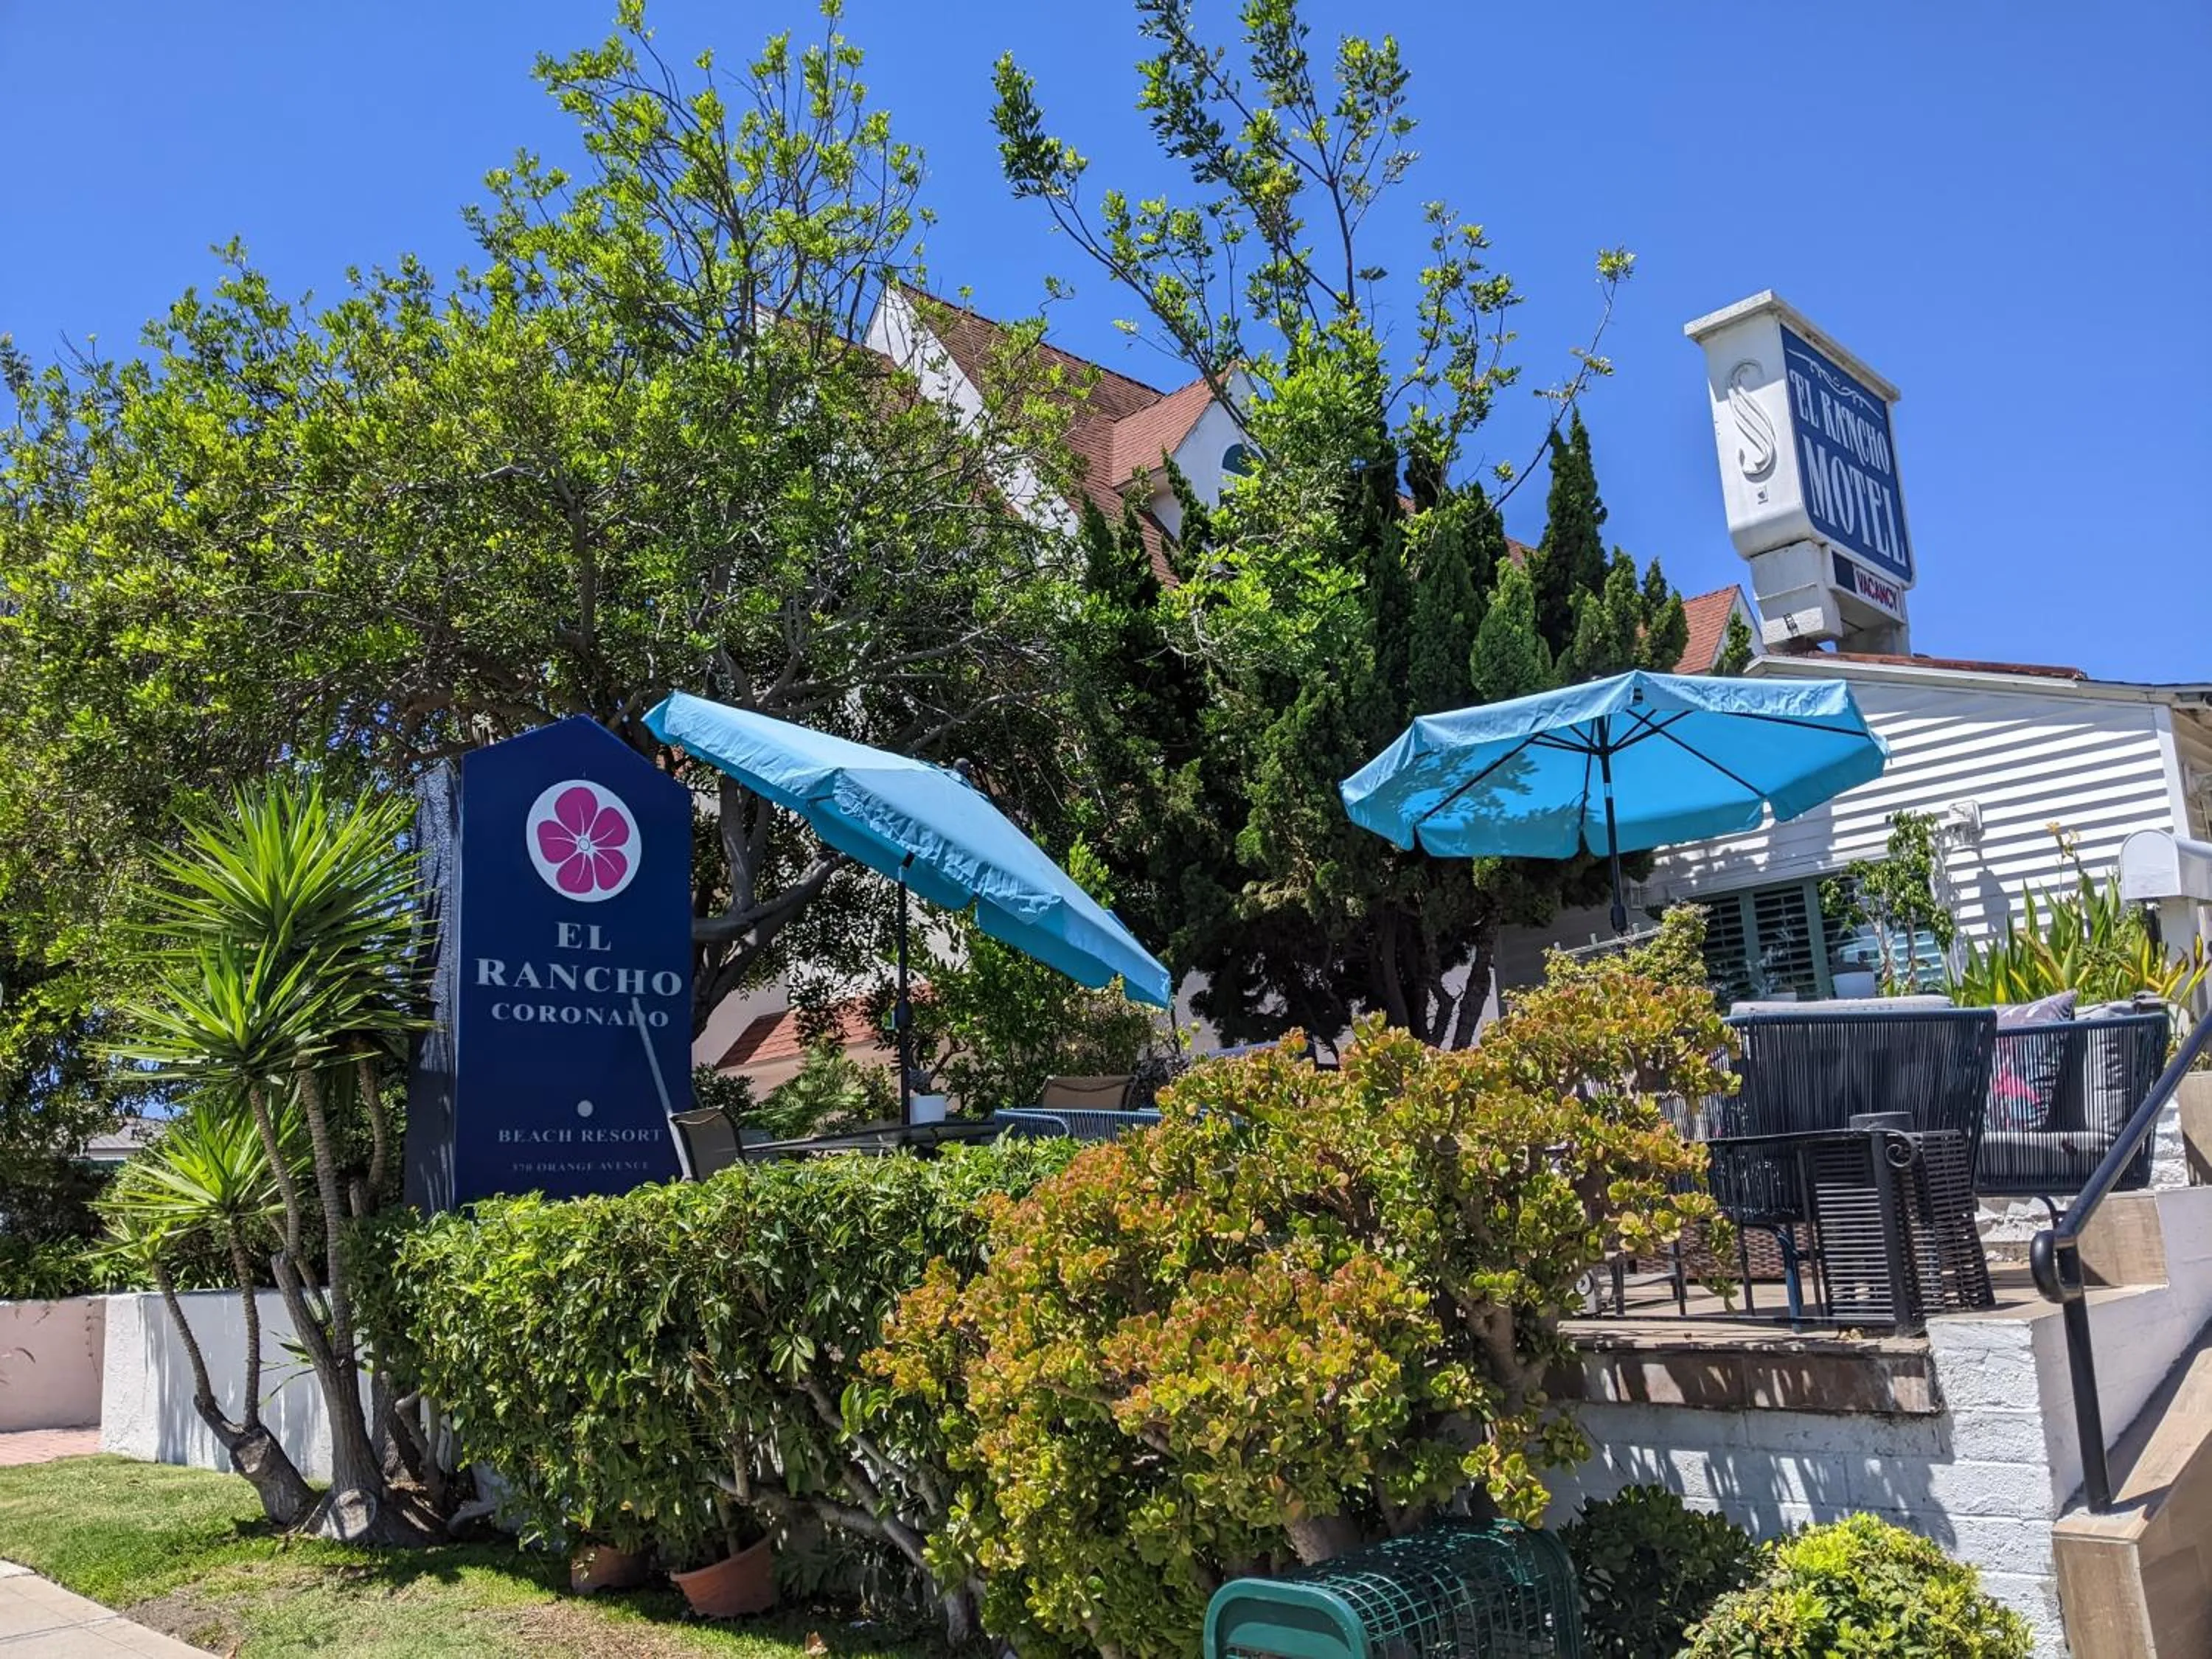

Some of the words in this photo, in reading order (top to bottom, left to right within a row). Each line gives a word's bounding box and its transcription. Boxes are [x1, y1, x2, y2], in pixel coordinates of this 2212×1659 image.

[1789, 369, 1819, 428] EL
[1820, 389, 1890, 476] RANCHO
[1802, 434, 1906, 567] MOTEL
[1857, 570, 1898, 611] VACANCY
[555, 922, 611, 950] EL
[475, 958, 682, 996] RANCHO
[498, 1130, 572, 1143] BEACH
[581, 1129, 662, 1142] RESORT
[537, 1162, 591, 1172] ORANGE
[600, 1161, 648, 1171] AVENUE
